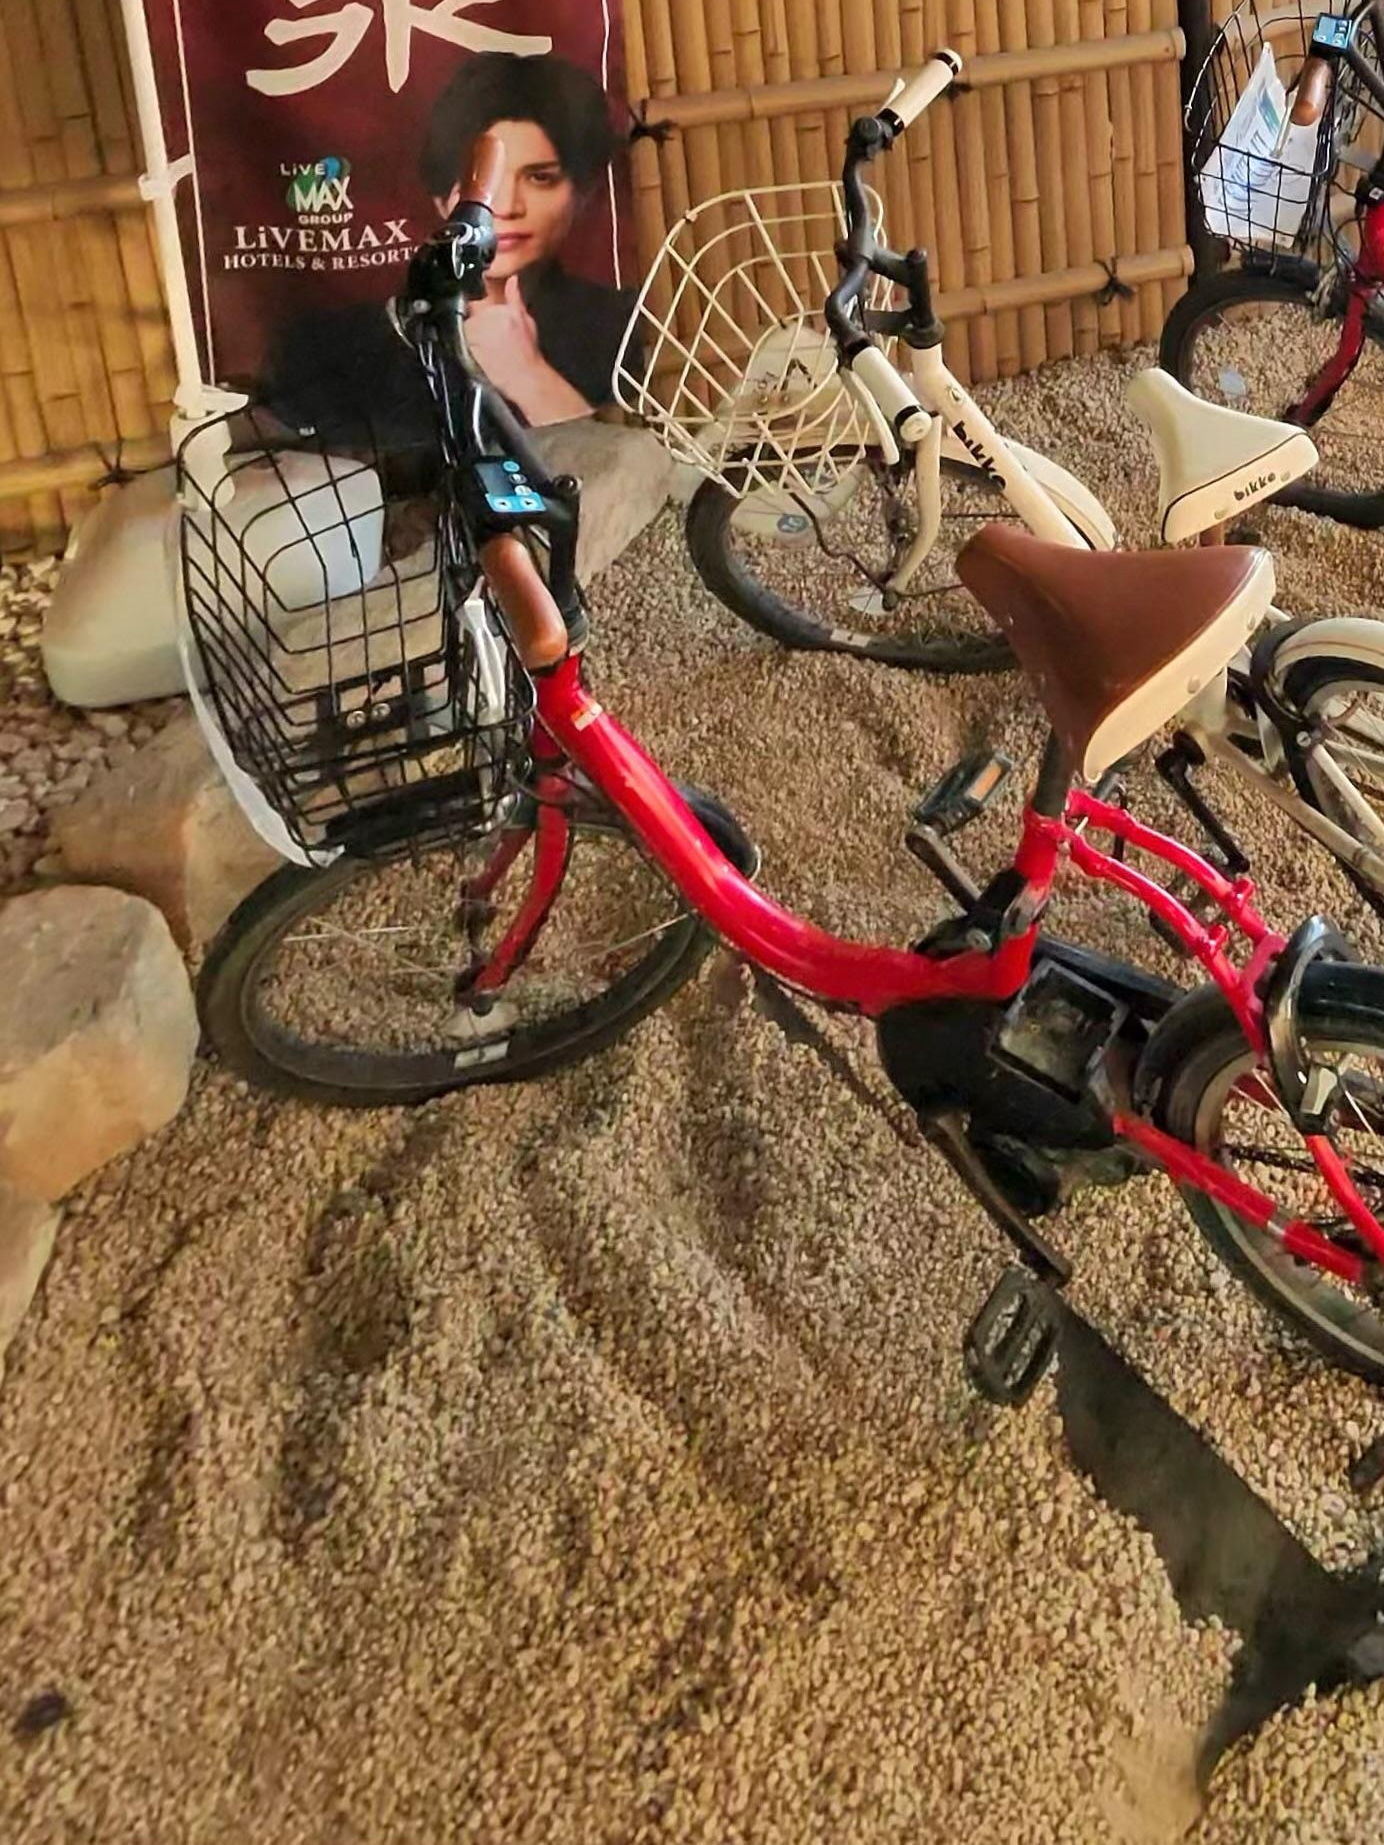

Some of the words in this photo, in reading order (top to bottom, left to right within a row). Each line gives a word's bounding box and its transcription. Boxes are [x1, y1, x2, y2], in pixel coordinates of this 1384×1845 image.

[294, 175, 354, 212] MAX
[298, 212, 354, 225] GROUP
[224, 253, 306, 269] HOTELS
[311, 257, 326, 271] &
[332, 245, 419, 270] RESORT
[1233, 472, 1276, 501] bikke
